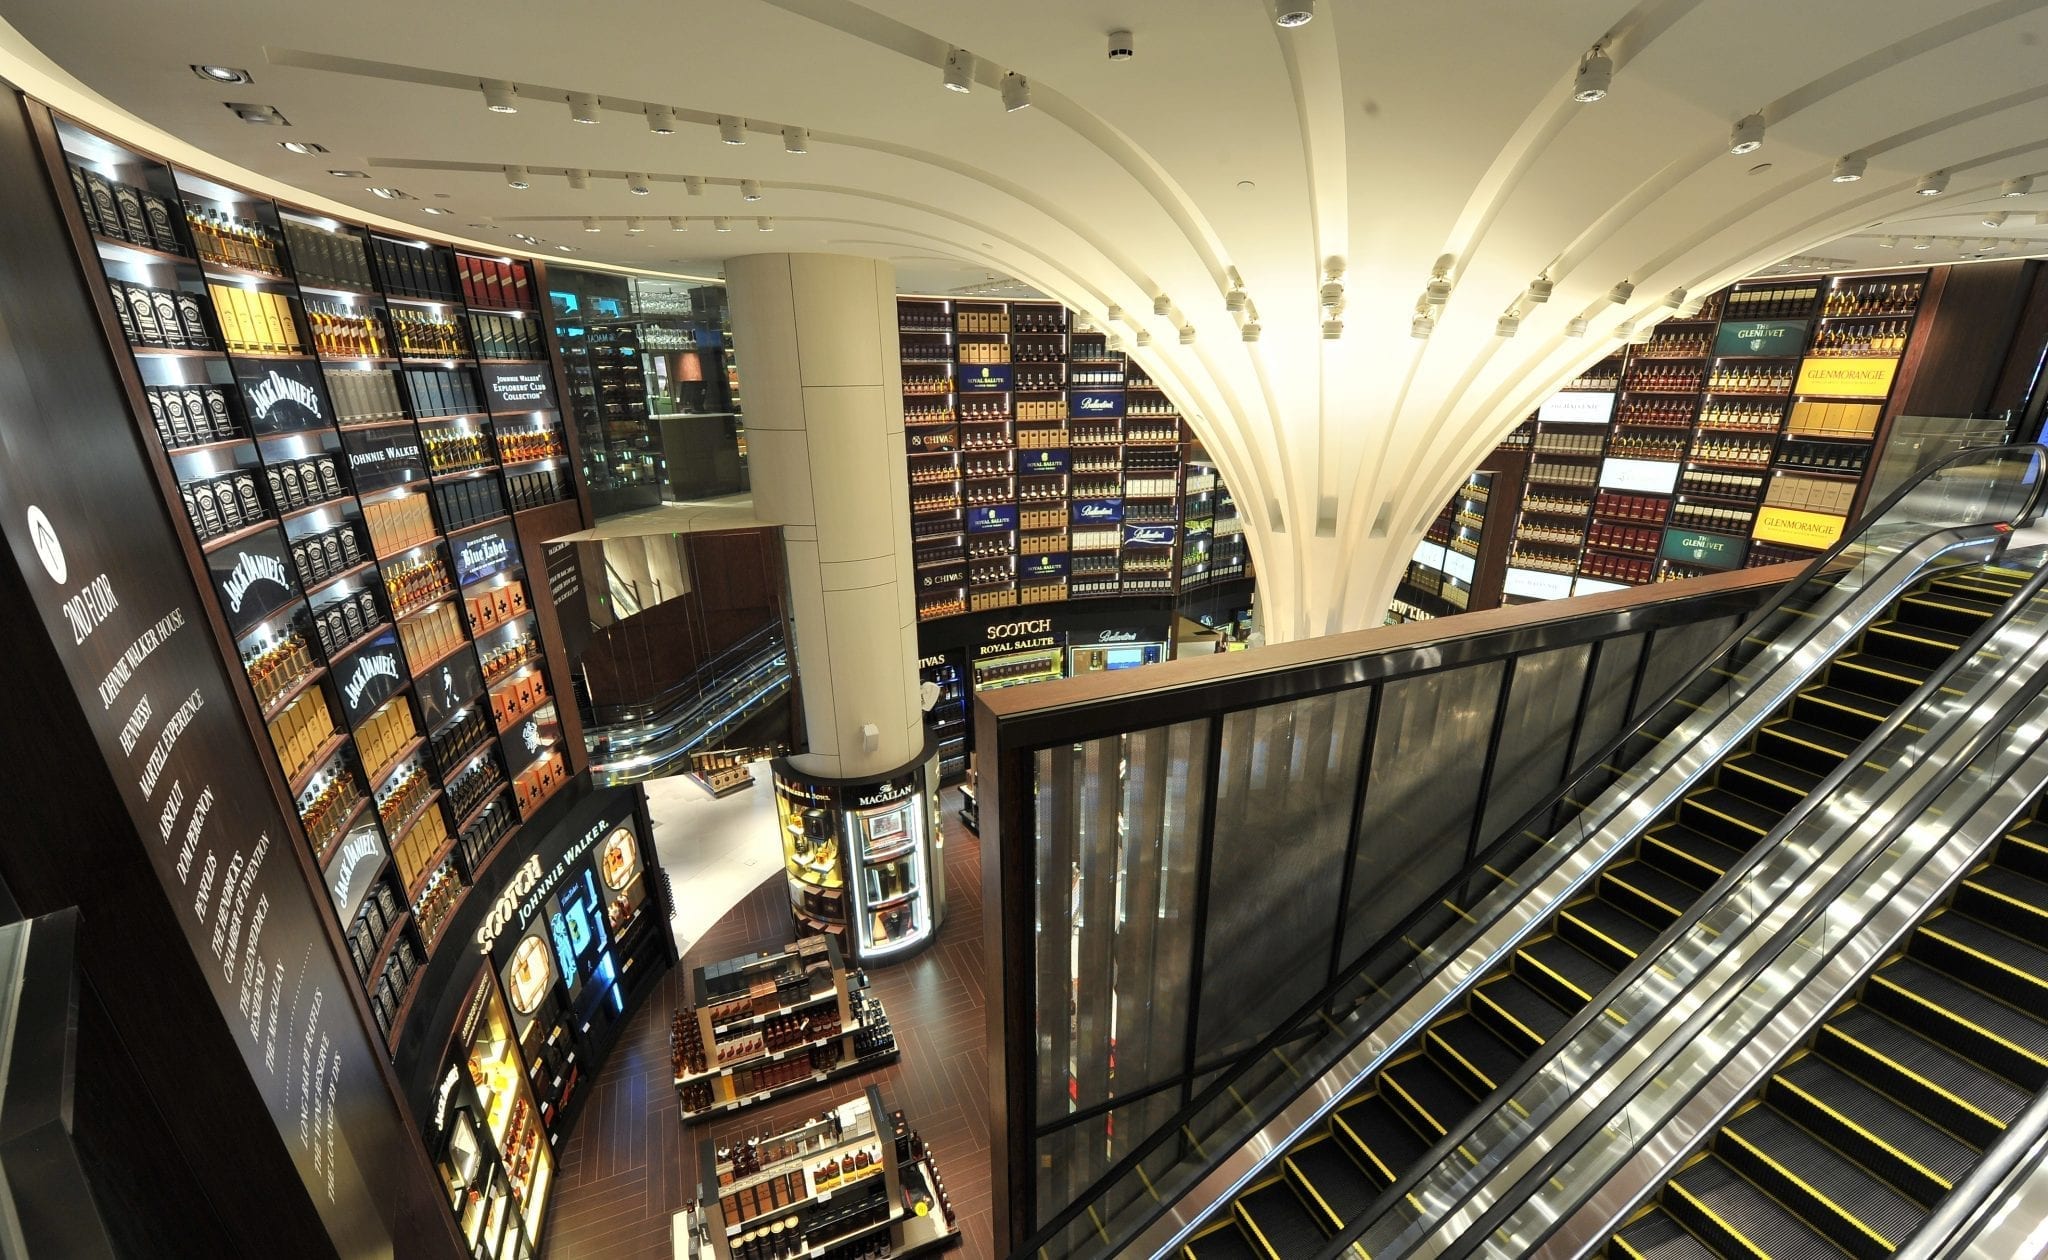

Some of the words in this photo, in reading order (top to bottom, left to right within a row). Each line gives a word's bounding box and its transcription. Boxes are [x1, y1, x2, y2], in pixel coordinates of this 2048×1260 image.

[1807, 369, 1888, 380] GLENMORANGIE
[248, 378, 277, 419] JACK
[349, 449, 385, 469] JOHNNIE
[386, 445, 419, 461] WALKER
[923, 434, 954, 445] CHIVAS
[1763, 517, 1835, 535] GLENMORANGIE
[222, 563, 250, 614] JACK
[934, 572, 964, 584] CHIVAS
[62, 594, 93, 646] 2ND
[81, 573, 119, 627] FLOOR
[987, 619, 1052, 641] SCOTCH
[98, 656, 132, 710] JOHNNIE
[124, 628, 160, 671] WALKER
[155, 607, 185, 643] HOUSE
[980, 643, 1013, 655] ROYAL
[1014, 636, 1054, 650] SALUTE
[344, 667, 367, 709] JACK
[119, 693, 153, 758] HENNESSY
[138, 740, 168, 803] MARTELL
[161, 688, 205, 752] EXPERIENCE
[158, 779, 184, 845] ABSOLUT
[859, 785, 913, 807] MACALLAN
[176, 840, 195, 886] DOM
[334, 858, 353, 909] JACK
[194, 849, 217, 925] PENFOLDS
[223, 910, 242, 984] CHAMBER
[235, 891, 245, 916] OF
[240, 830, 270, 901] INVENTION
[477, 854, 544, 955] SCOTCH
[517, 862, 565, 930] JOHNNIE
[211, 921, 226, 961] THE
[243, 892, 270, 987] GLENFIDDICH
[239, 981, 251, 1020] THE
[250, 955, 266, 1045] RESIDENCE
[268, 957, 285, 1039] MACALLAN
[305, 986, 323, 1049] RAFFLES
[265, 1035, 276, 1075] THE
[302, 1041, 311, 1069] BY
[315, 1031, 330, 1095] RESERVE
[301, 1067, 310, 1104] BAR
[300, 1097, 309, 1151] LONG
[314, 1137, 322, 1177] THE
[327, 1163, 336, 1206] THE
